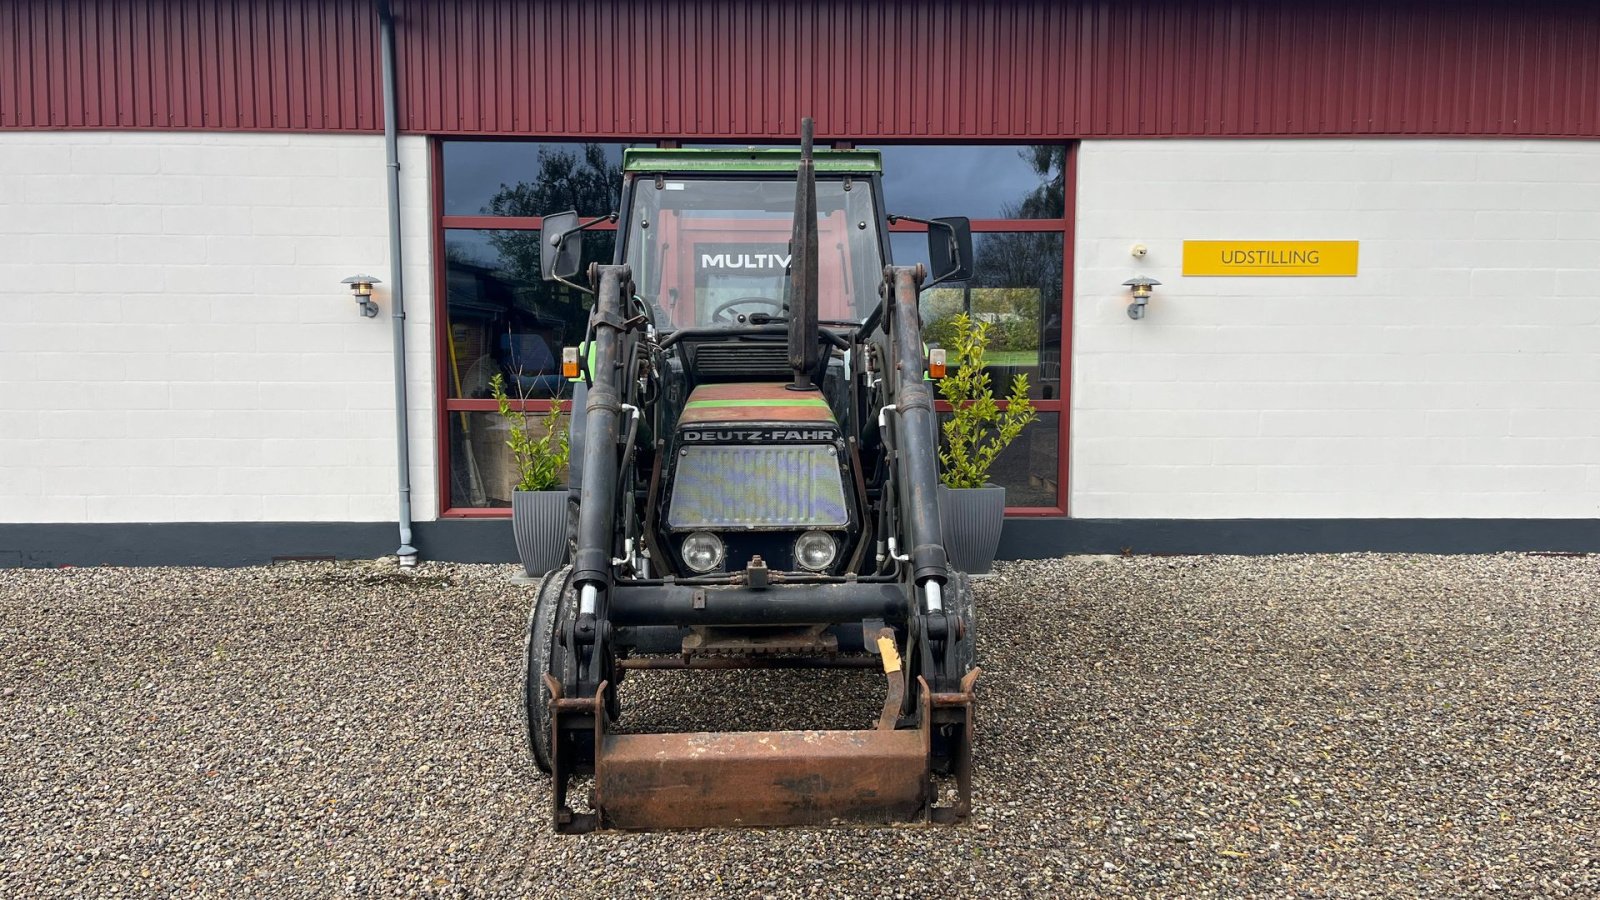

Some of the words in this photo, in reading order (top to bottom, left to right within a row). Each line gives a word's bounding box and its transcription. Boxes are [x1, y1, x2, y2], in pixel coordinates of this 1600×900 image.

[702, 254, 792, 268] MULTIV
[1221, 250, 1319, 264] UDSTILLING
[684, 431, 833, 441] DEUTZ-FAHR
